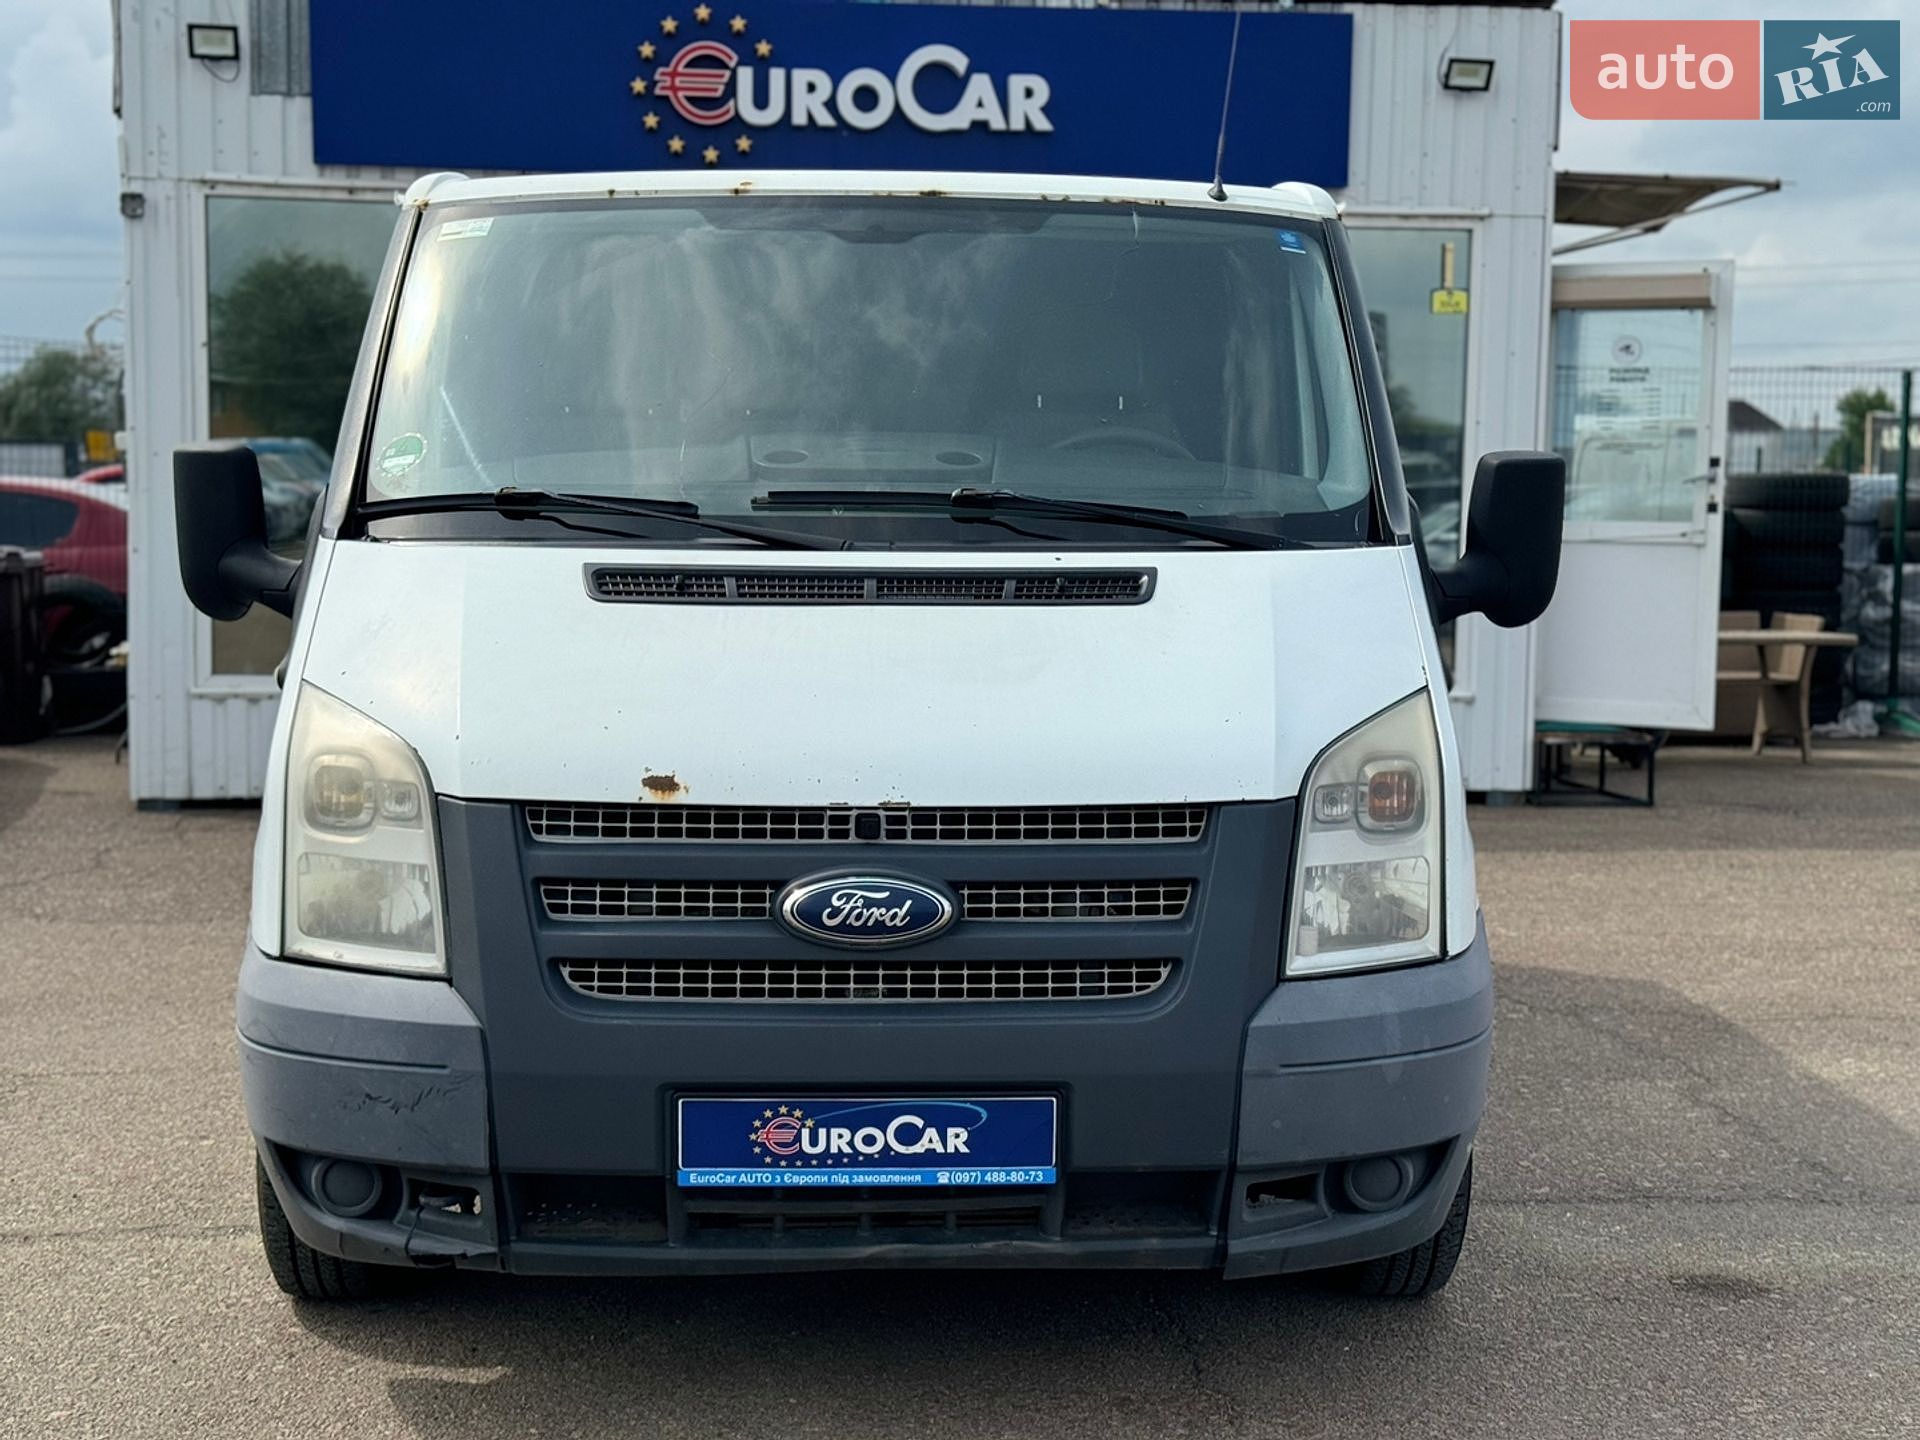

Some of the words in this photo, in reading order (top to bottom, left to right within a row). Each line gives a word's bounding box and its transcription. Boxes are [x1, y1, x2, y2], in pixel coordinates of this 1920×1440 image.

[821, 889, 913, 927] Ford
[689, 1173, 736, 1184] EuroCar
[851, 1173, 922, 1184] замовлення
[950, 1171, 982, 1185] (097)
[984, 1170, 1044, 1183] 488-80-73
